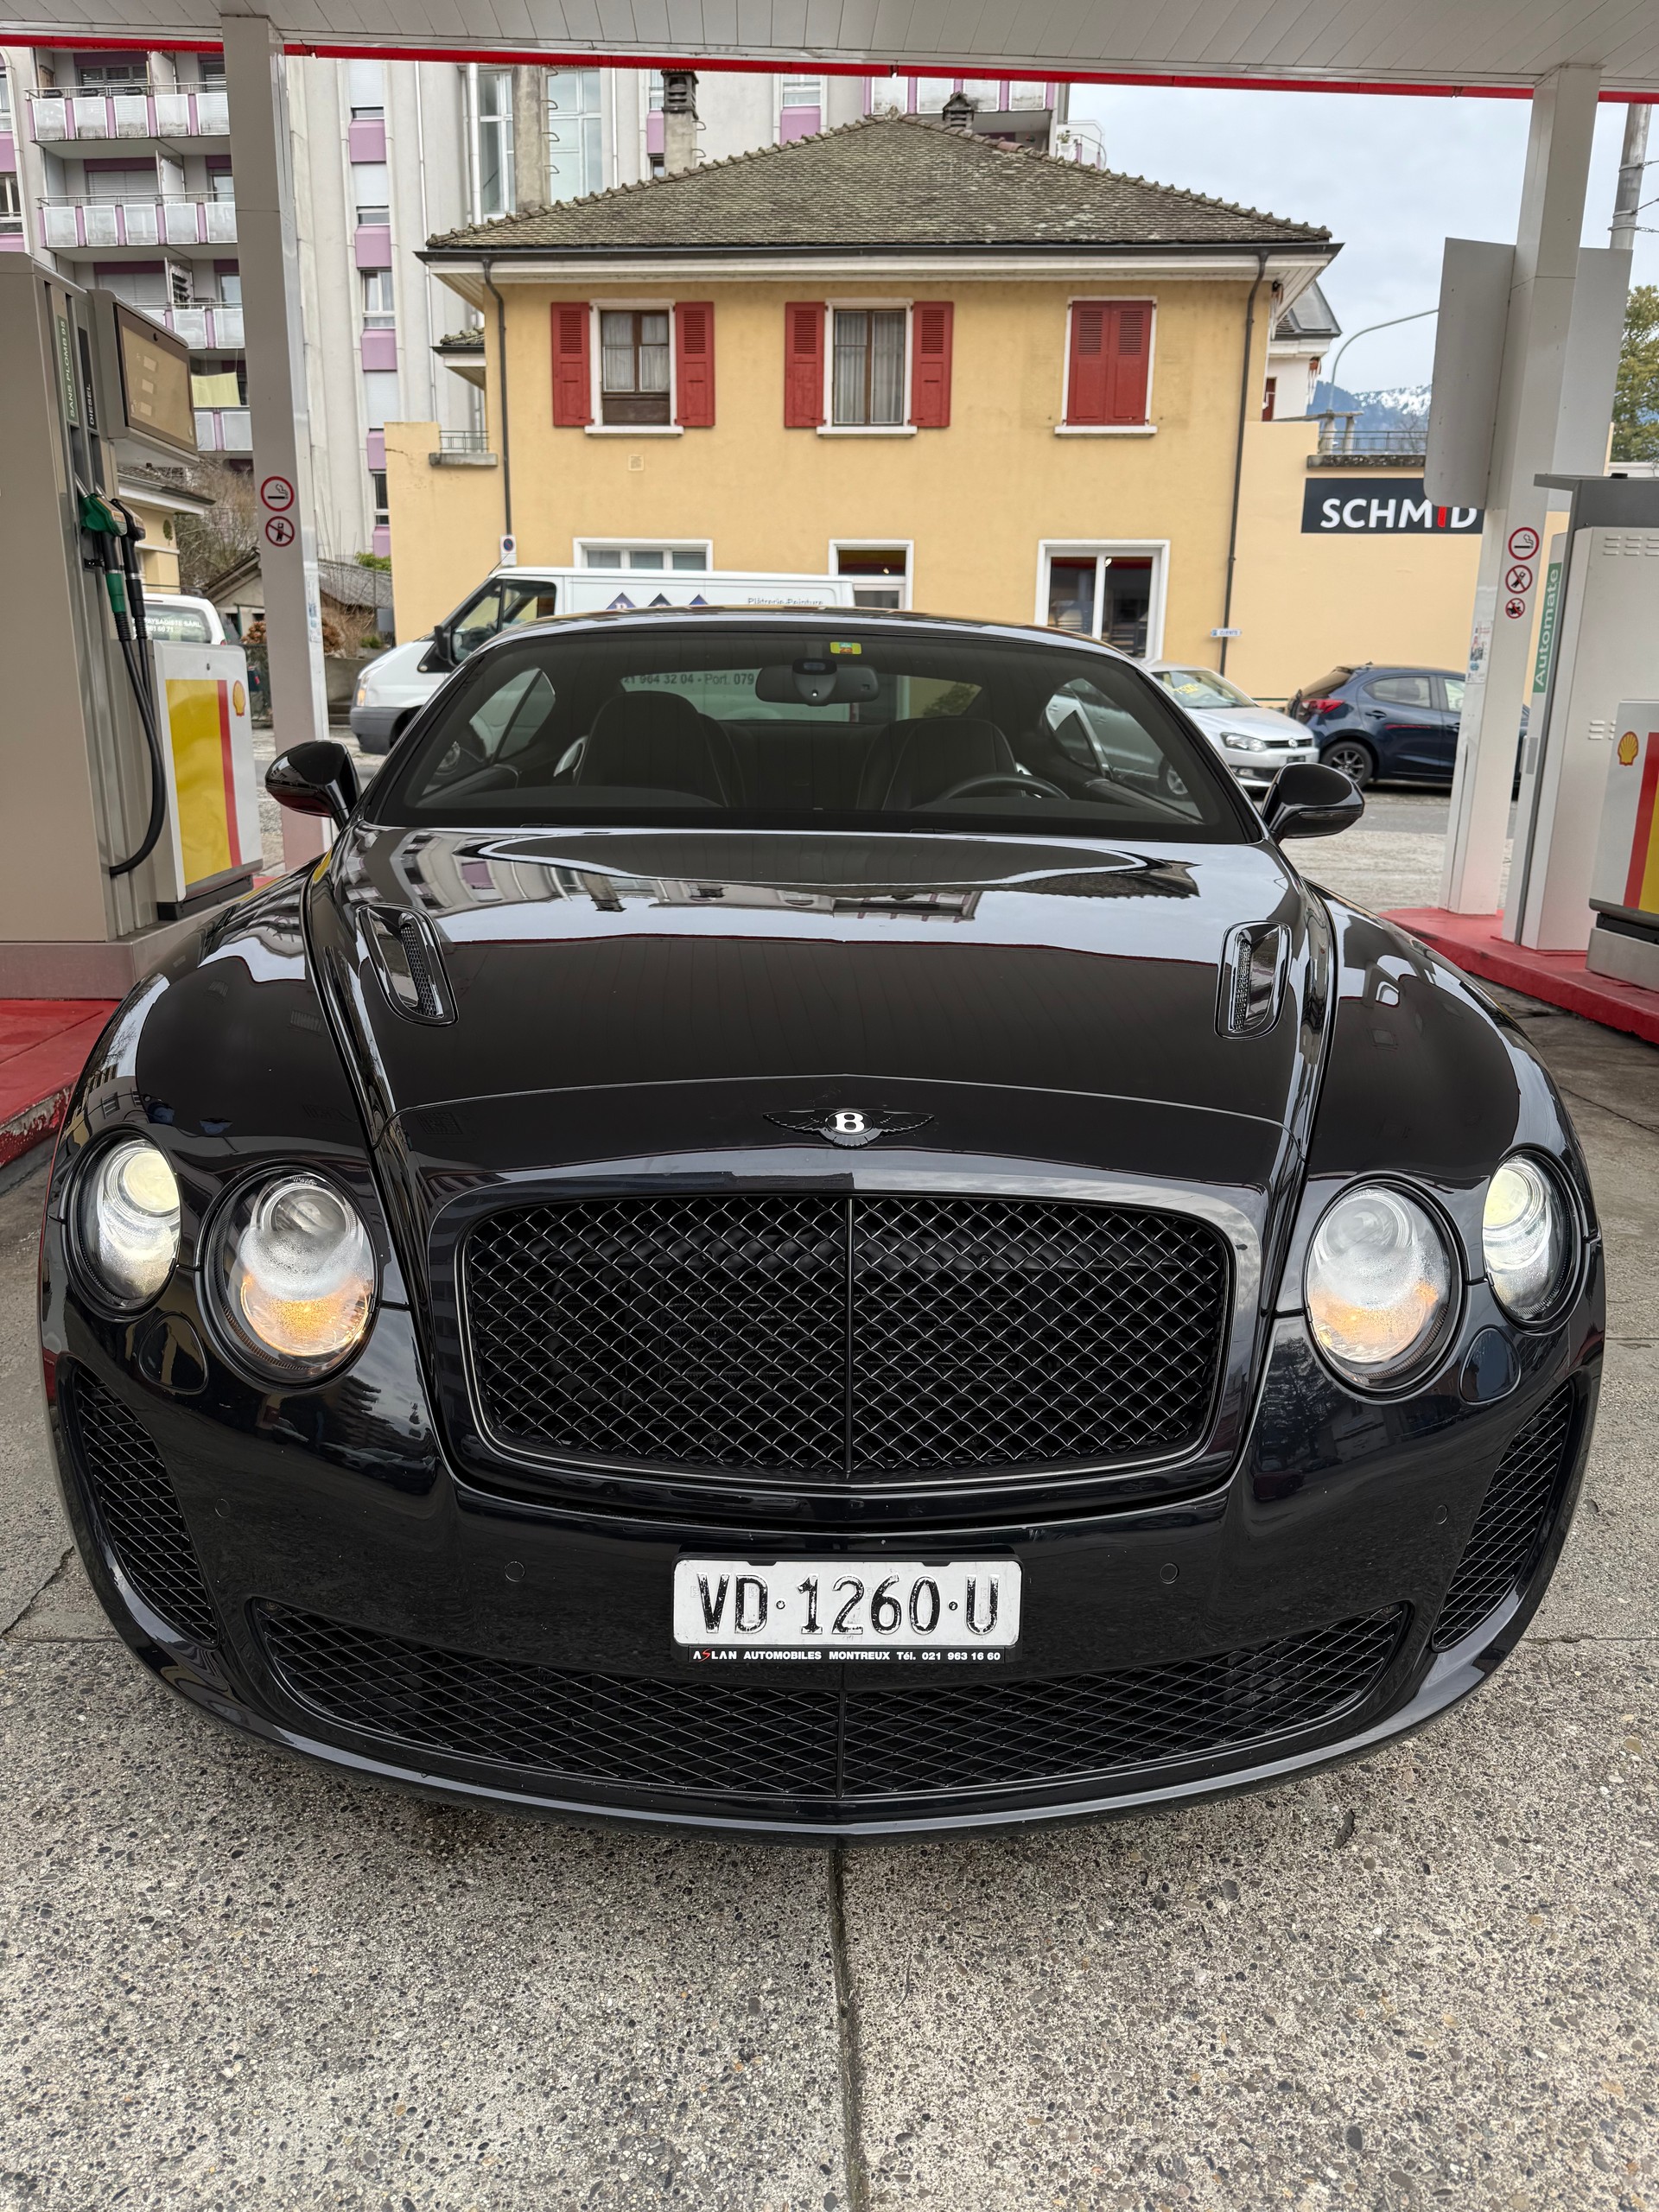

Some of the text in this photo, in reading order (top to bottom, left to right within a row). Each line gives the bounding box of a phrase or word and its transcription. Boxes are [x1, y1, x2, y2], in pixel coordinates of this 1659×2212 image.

[60, 321, 66, 335] 95
[1320, 498, 1478, 529] SCHMID
[1535, 569, 1559, 687] Automate
[664, 673, 677, 684] 32
[680, 673, 694, 684] 04
[734, 672, 755, 685] 079
[835, 1112, 865, 1133] B
[693, 1648, 1001, 1662] ASLAN AUTOMOBILES MONTREUX Tél. 021 963 16 60
